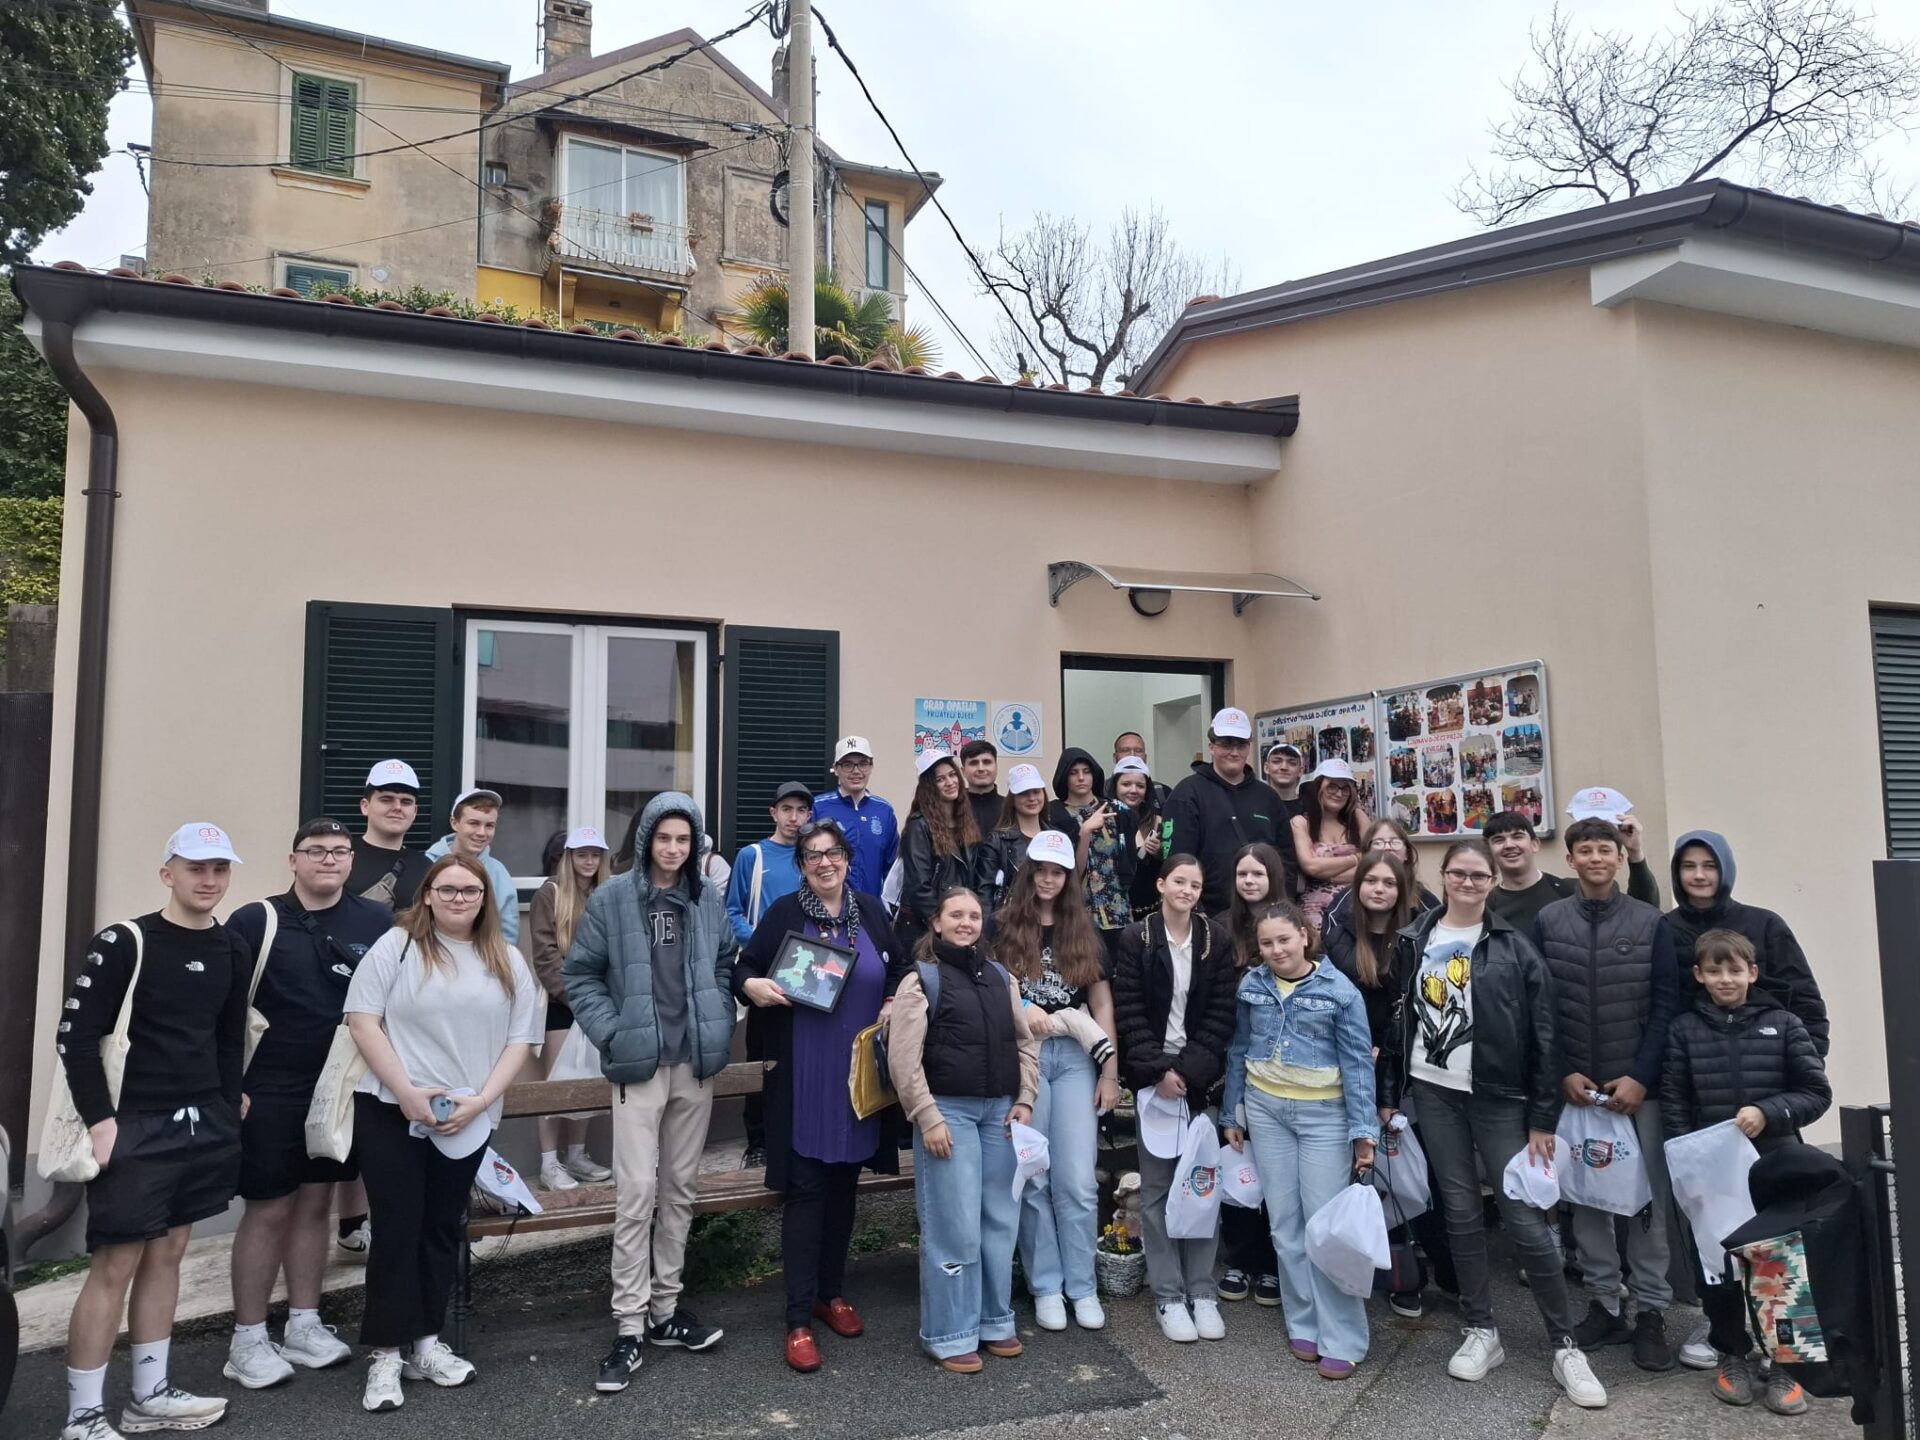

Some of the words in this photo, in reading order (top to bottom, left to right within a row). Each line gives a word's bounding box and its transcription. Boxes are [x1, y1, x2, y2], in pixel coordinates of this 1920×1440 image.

[923, 699, 944, 711] GRAD
[946, 701, 977, 712] OPATIJA
[1338, 704, 1366, 715] OPATIJA
[957, 711, 975, 719] DJECE
